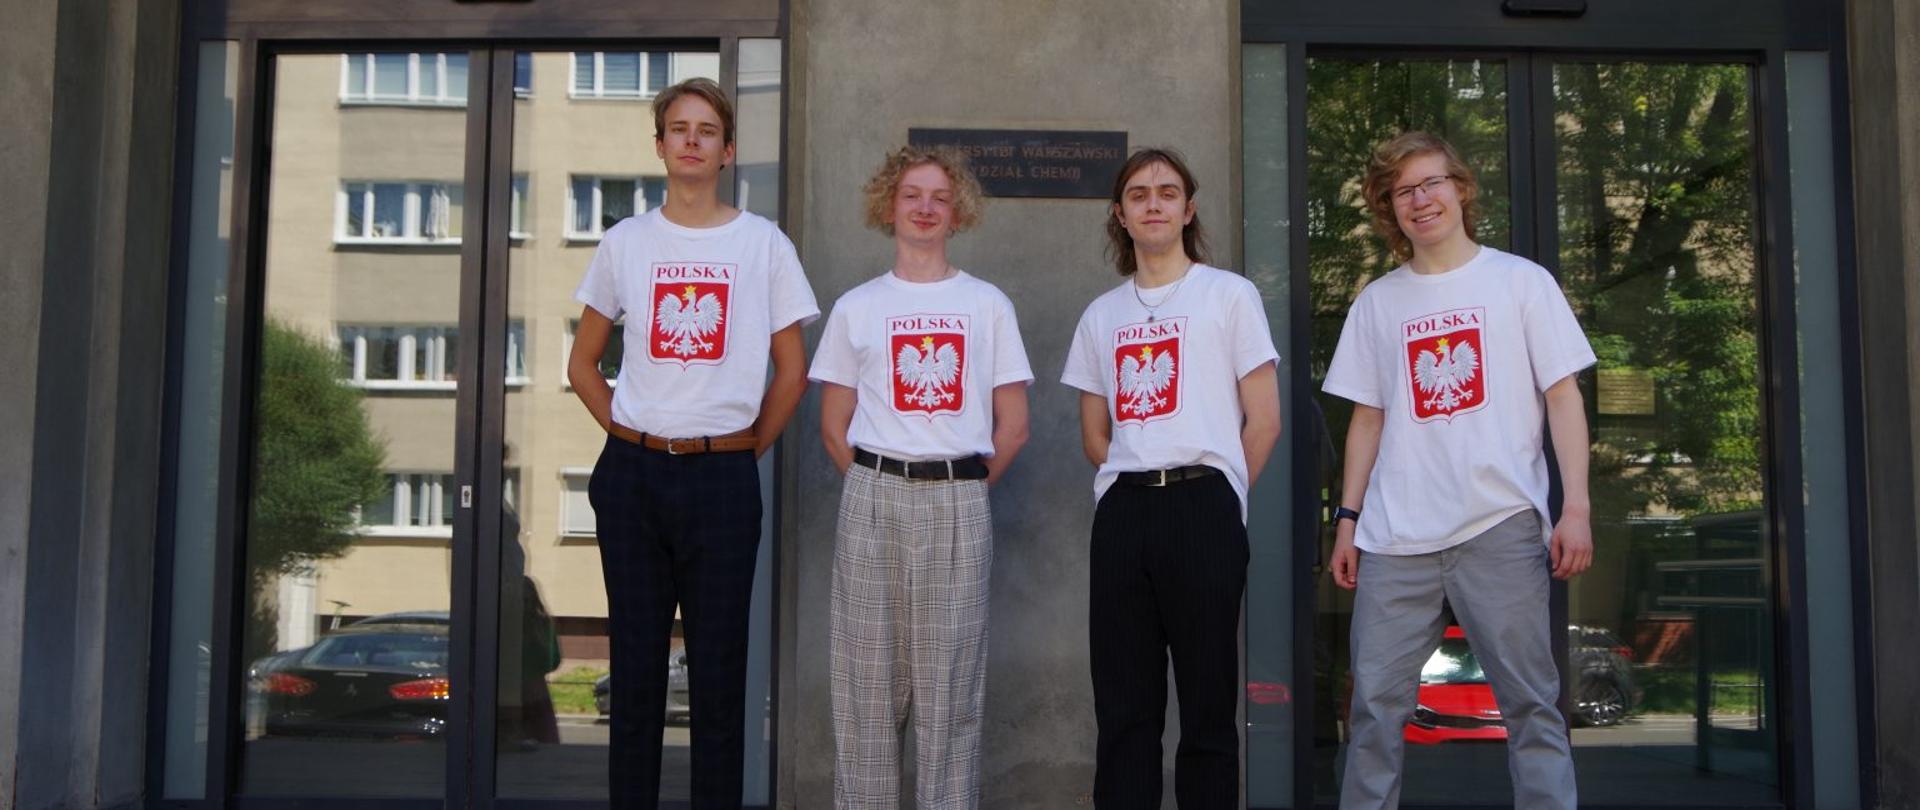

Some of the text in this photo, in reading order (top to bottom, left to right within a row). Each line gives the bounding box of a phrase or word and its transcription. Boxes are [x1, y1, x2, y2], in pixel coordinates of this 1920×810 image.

[1021, 146, 1120, 159] WARSZAWSKI
[656, 266, 729, 278] POLSKA
[893, 318, 964, 331] POLSKA
[1407, 312, 1479, 336] POLSKA
[1118, 321, 1179, 343] POLSKA
